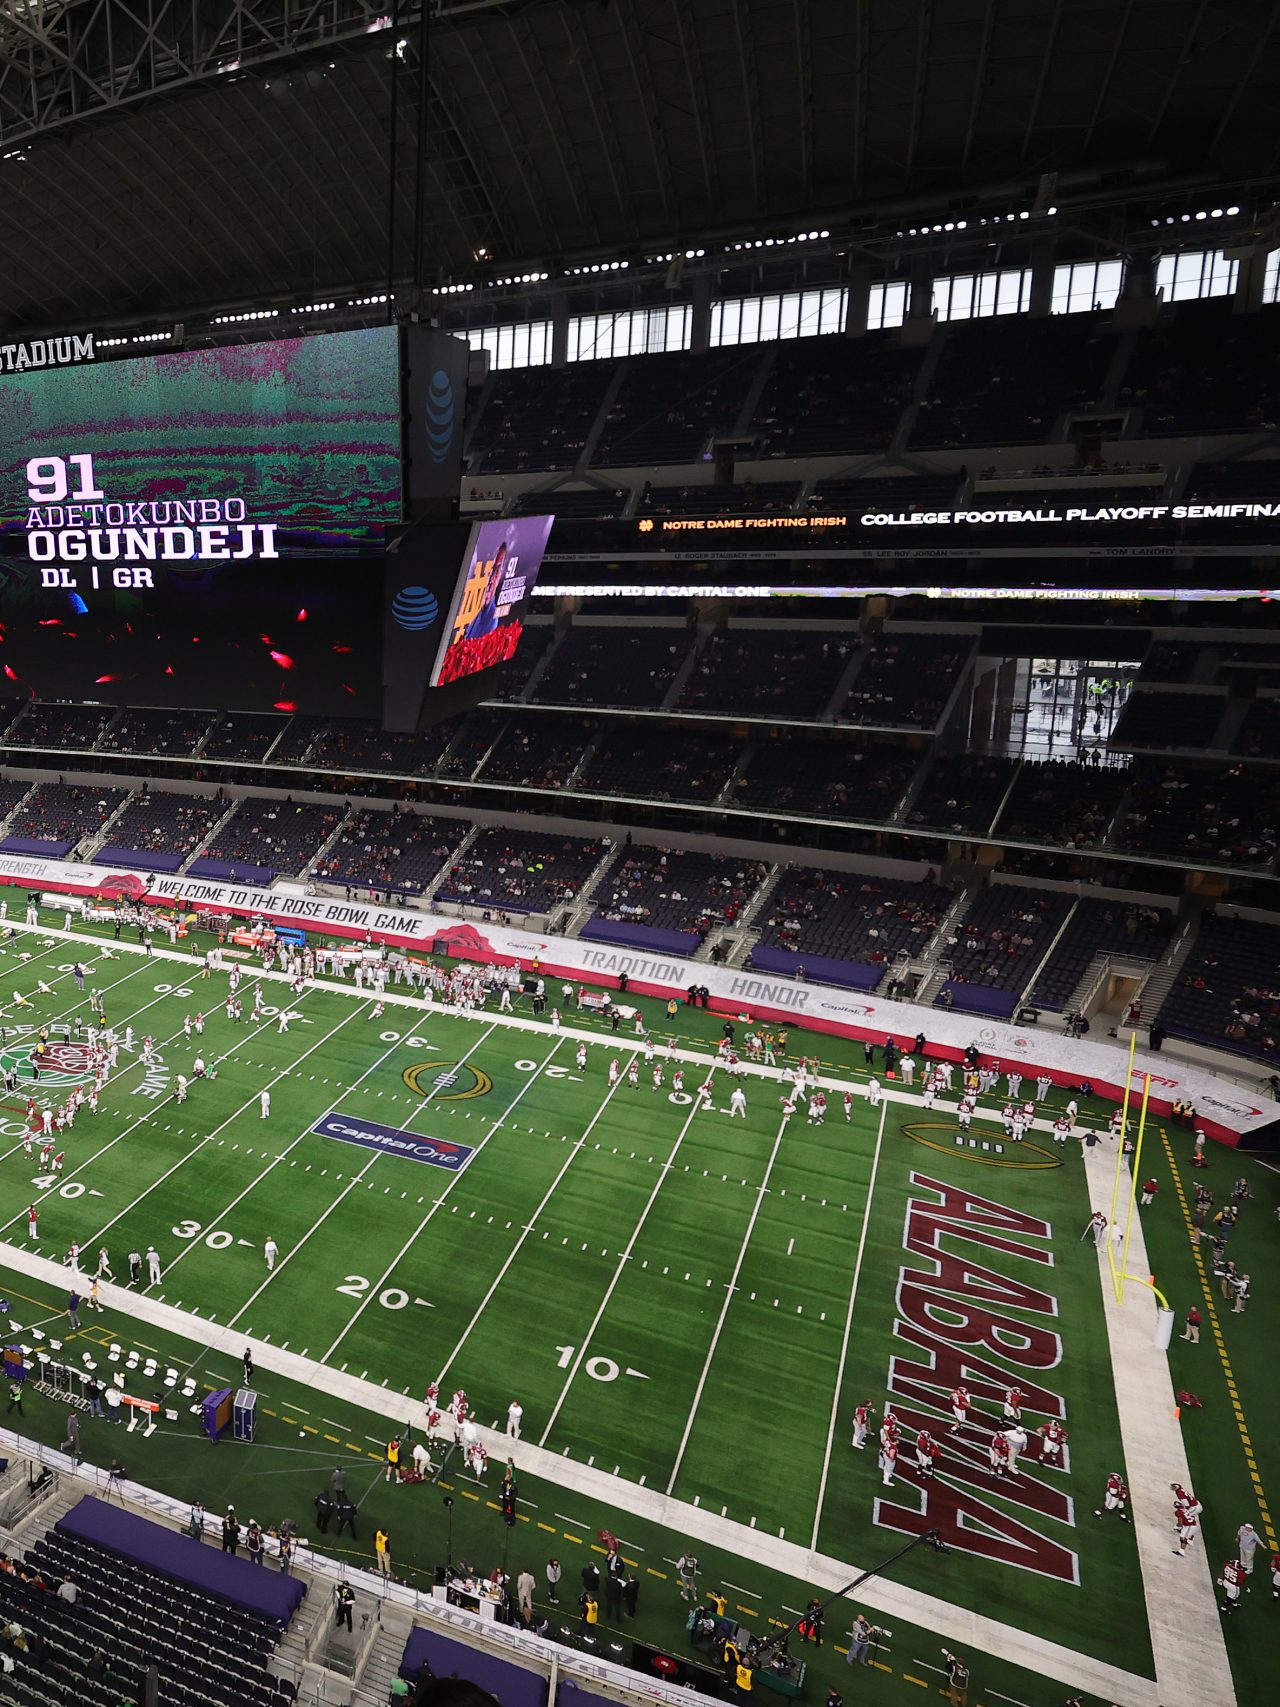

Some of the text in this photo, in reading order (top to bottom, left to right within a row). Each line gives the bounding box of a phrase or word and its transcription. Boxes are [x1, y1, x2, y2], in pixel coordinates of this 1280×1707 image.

[25, 453, 104, 503] 91
[25, 498, 246, 529] ADETOKUNBO
[663, 516, 846, 530] NOTRE DAME FIGHTING IRISH
[860, 511, 950, 526] COLLEGE
[954, 509, 1062, 523] FOOTBALL
[1066, 506, 1169, 521] PLAYOFF
[28, 524, 279, 562] OGUNDEJI
[41, 566, 154, 588] DL GR
[505, 556, 519, 578] 91
[560, 586, 642, 597] PRESENTED
[644, 586, 664, 597] BY
[667, 586, 735, 597] CAPITAL
[737, 586, 771, 597] ONE
[951, 589, 1139, 600] NOTRE DAME FIGHTING IRISH
[157, 880, 423, 935] WELCOME TO THE ROSE BOWL GAME
[581, 949, 686, 983] TRADITION
[153, 983, 195, 998] 50
[730, 977, 809, 1009] HONOR
[379, 1030, 428, 1047] 30
[514, 1059, 569, 1079] 20
[1202, 1095, 1240, 1114] Capital
[326, 1122, 459, 1164] Capital One
[30, 1173, 87, 1200] 40
[170, 1219, 234, 1250] 30
[335, 1275, 410, 1310] 20
[553, 1345, 620, 1381] 10
[872, 1170, 1081, 1588] ALABAMA
[1224, 1565, 1238, 1583] 95
